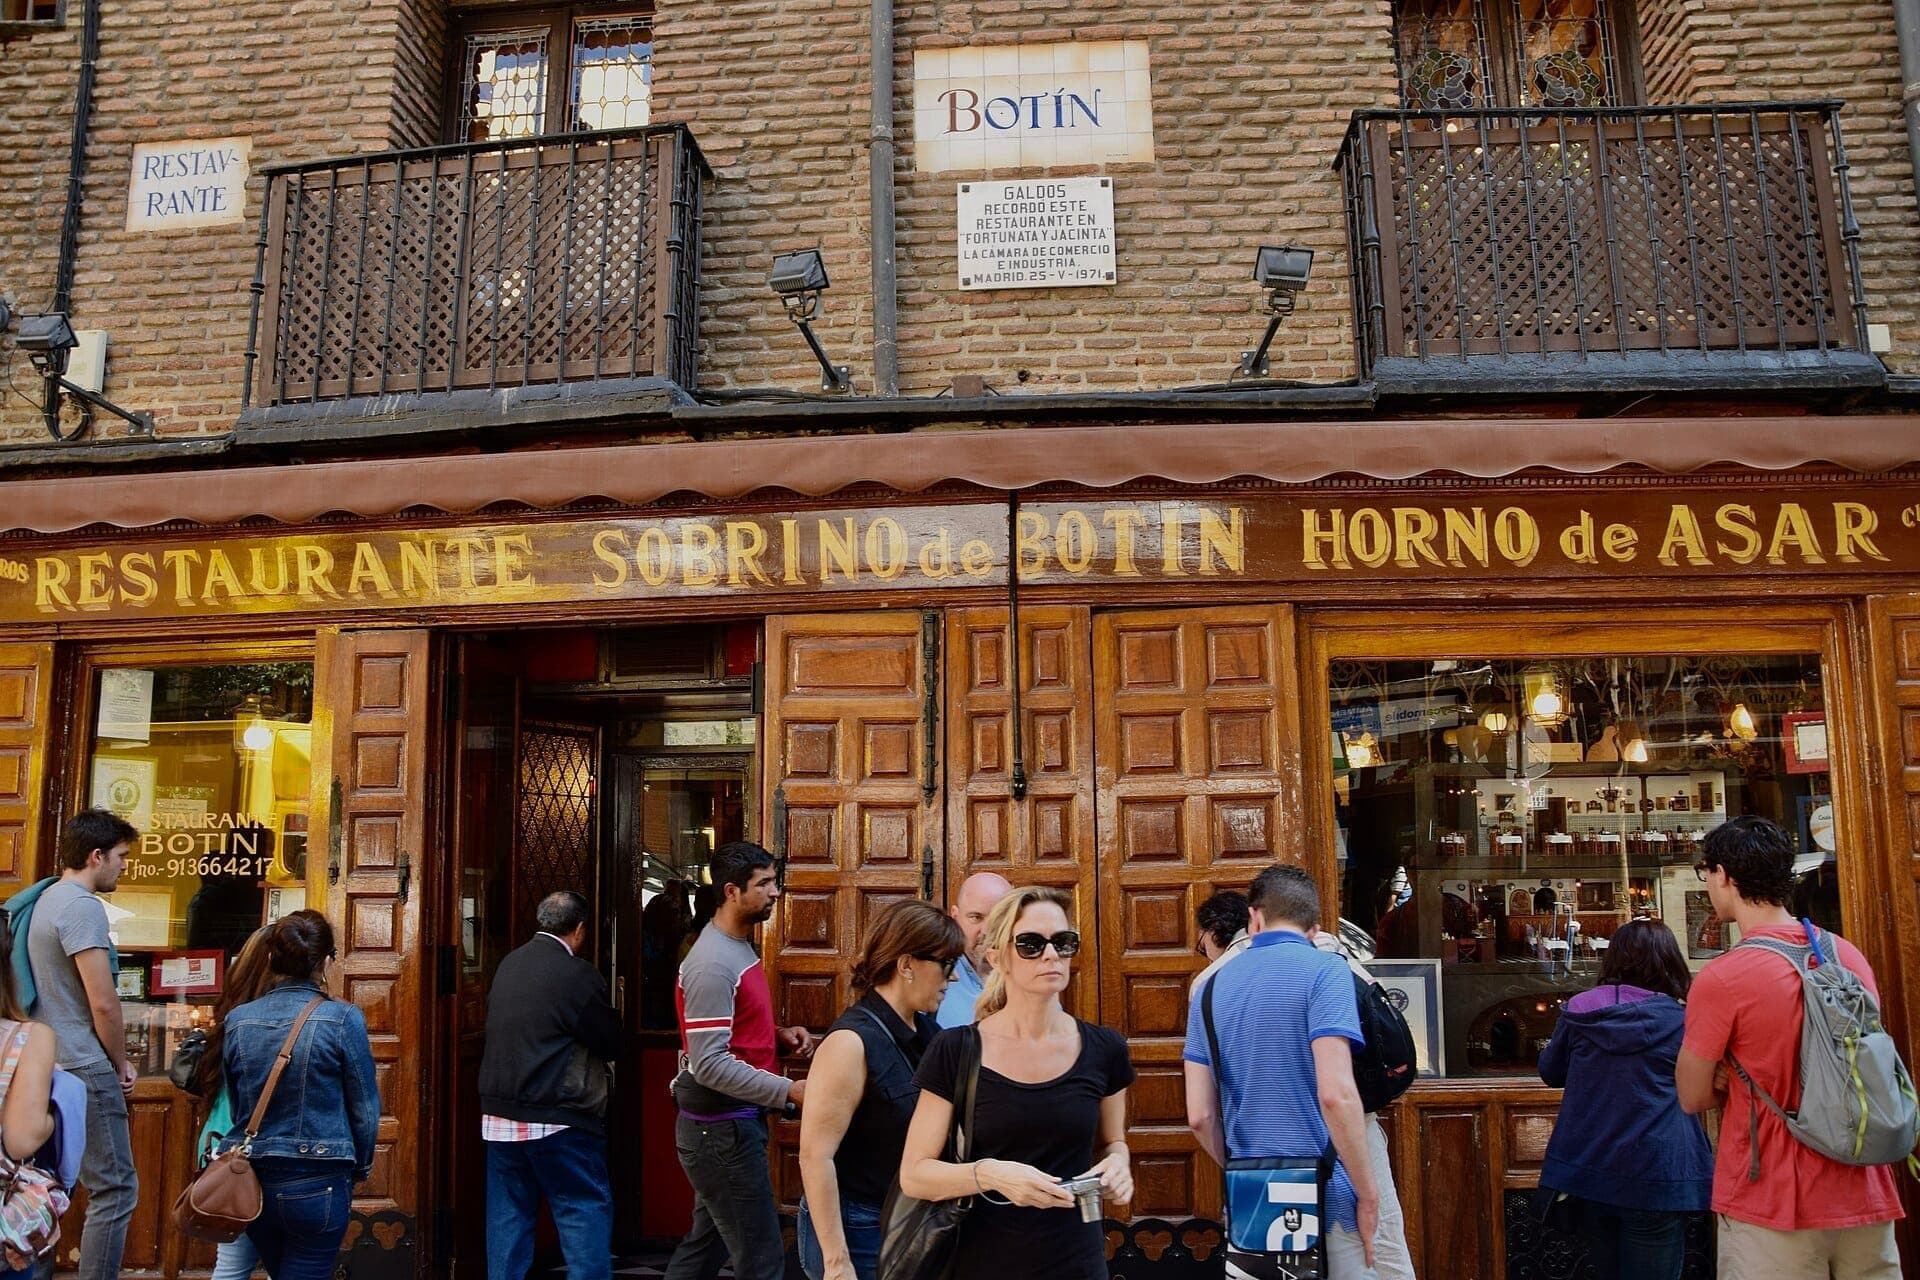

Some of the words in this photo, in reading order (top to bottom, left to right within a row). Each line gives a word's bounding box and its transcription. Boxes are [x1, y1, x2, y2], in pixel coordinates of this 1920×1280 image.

[147, 186, 227, 217] RANTE
[1050, 200, 1087, 213] ESTE
[976, 215, 1073, 230] RESTAURANTE
[1078, 214, 1096, 226] EN
[1041, 229, 1048, 242] Y
[964, 249, 978, 260] LA
[1032, 247, 1047, 257] DE
[1049, 244, 1110, 256] COMERCIO
[997, 260, 1005, 270] E
[35, 534, 536, 613] RESTAURANTE
[592, 516, 905, 589] SOBRINO
[918, 525, 994, 578] de
[1016, 506, 1246, 578] BOTIN
[1300, 506, 1541, 569] HORNO
[1558, 510, 1639, 565] de
[1657, 501, 1892, 567] ASAR
[141, 832, 258, 855] BOTIN
